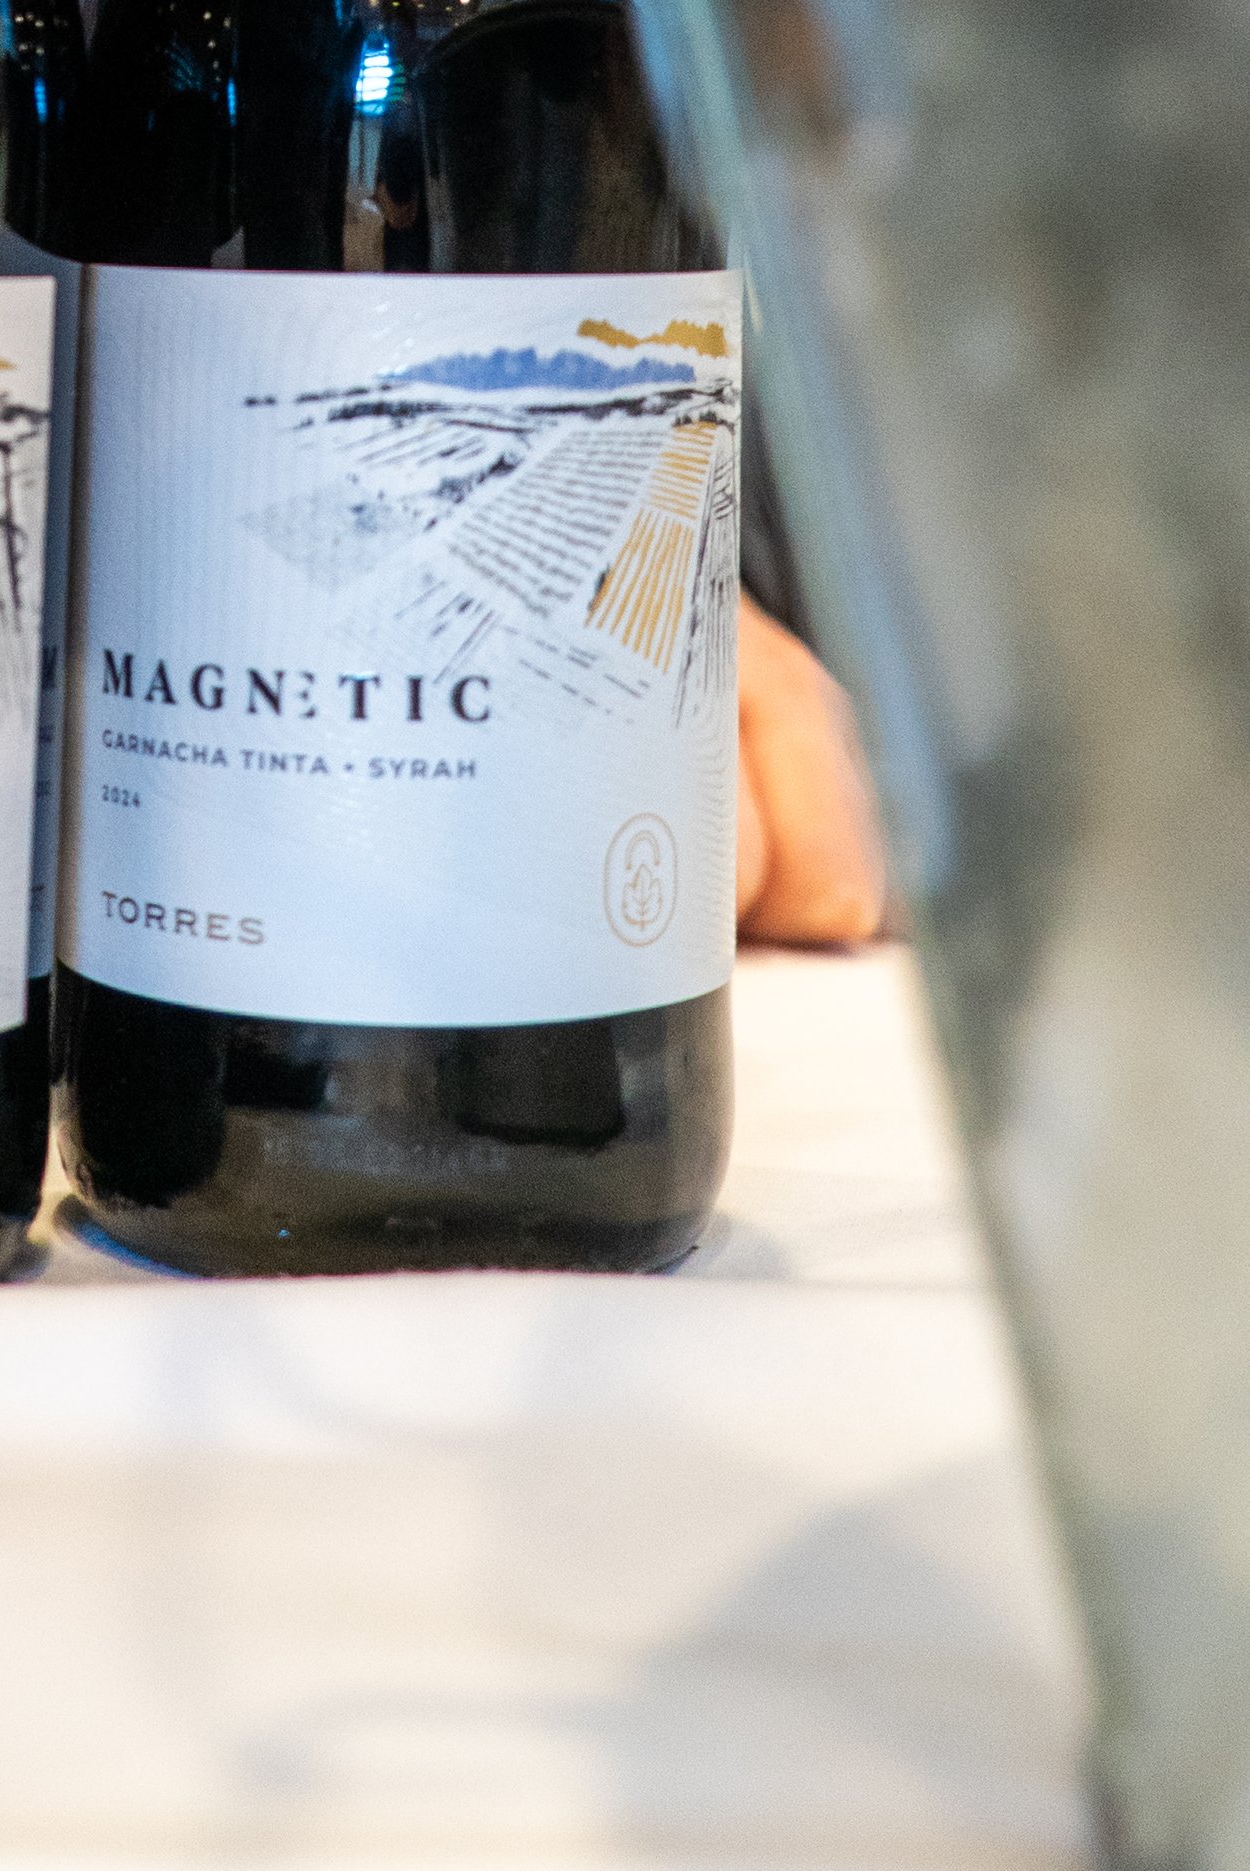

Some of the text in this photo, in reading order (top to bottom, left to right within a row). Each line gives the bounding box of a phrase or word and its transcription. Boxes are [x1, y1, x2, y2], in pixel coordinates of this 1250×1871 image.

[102, 647, 490, 722] MAGNETIC
[102, 728, 477, 778] GARNACHA TINTA SYRAH
[102, 890, 265, 946] TORRES
